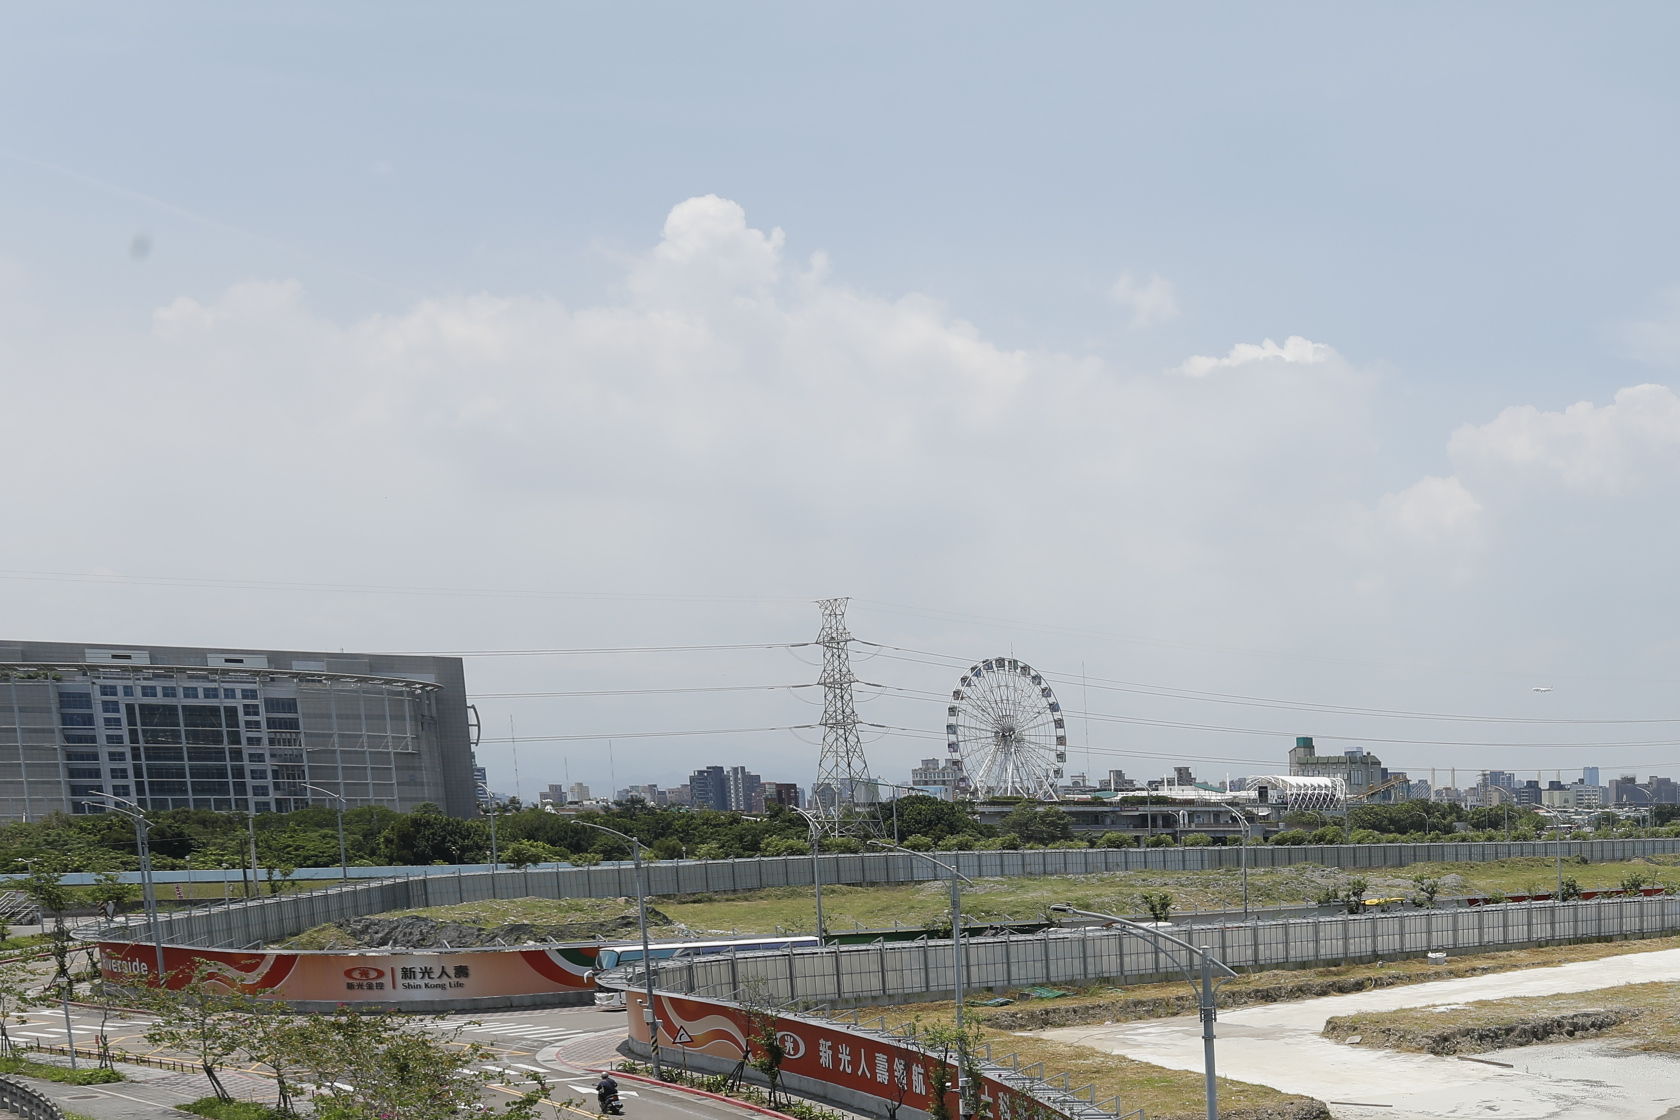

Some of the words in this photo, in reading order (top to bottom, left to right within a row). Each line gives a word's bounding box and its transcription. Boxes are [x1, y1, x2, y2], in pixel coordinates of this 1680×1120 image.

[401, 965, 470, 980] 新光人壽
[346, 981, 385, 991] 新光金控
[424, 981, 446, 990] Kong
[784, 1035, 795, 1055] 光
[819, 1038, 926, 1096] 新光人壽領航
